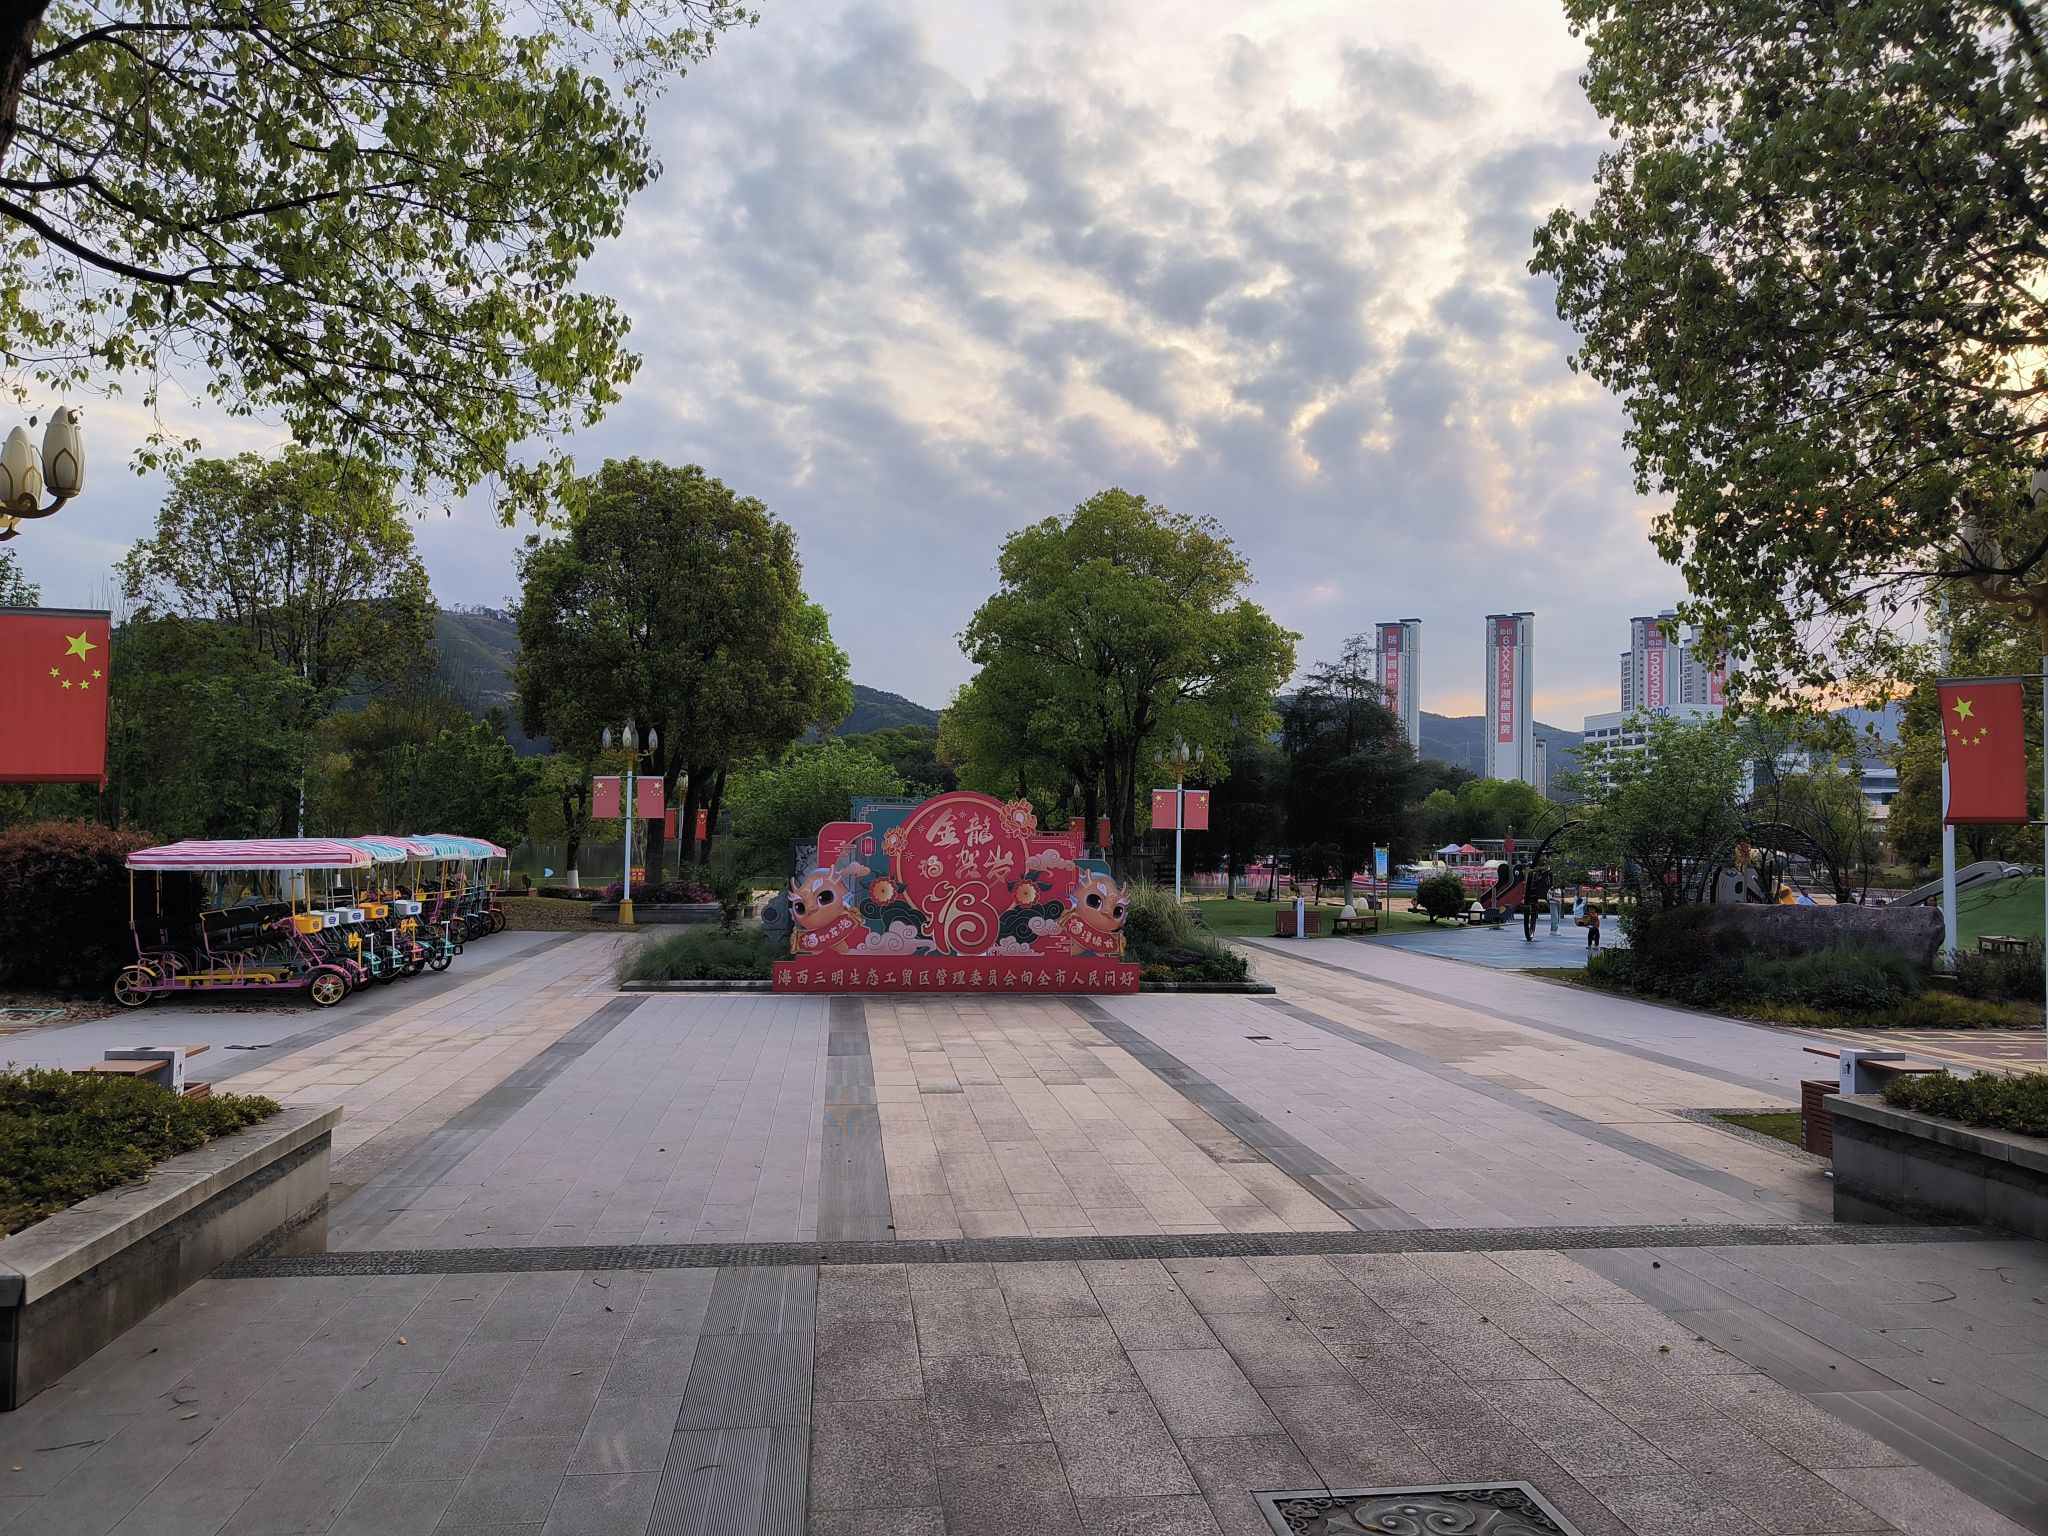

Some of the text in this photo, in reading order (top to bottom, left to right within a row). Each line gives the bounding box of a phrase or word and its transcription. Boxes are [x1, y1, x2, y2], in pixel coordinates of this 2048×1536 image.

[777, 968, 1135, 988] 海西三明生态工贸区管理委员会向全市人民问好
